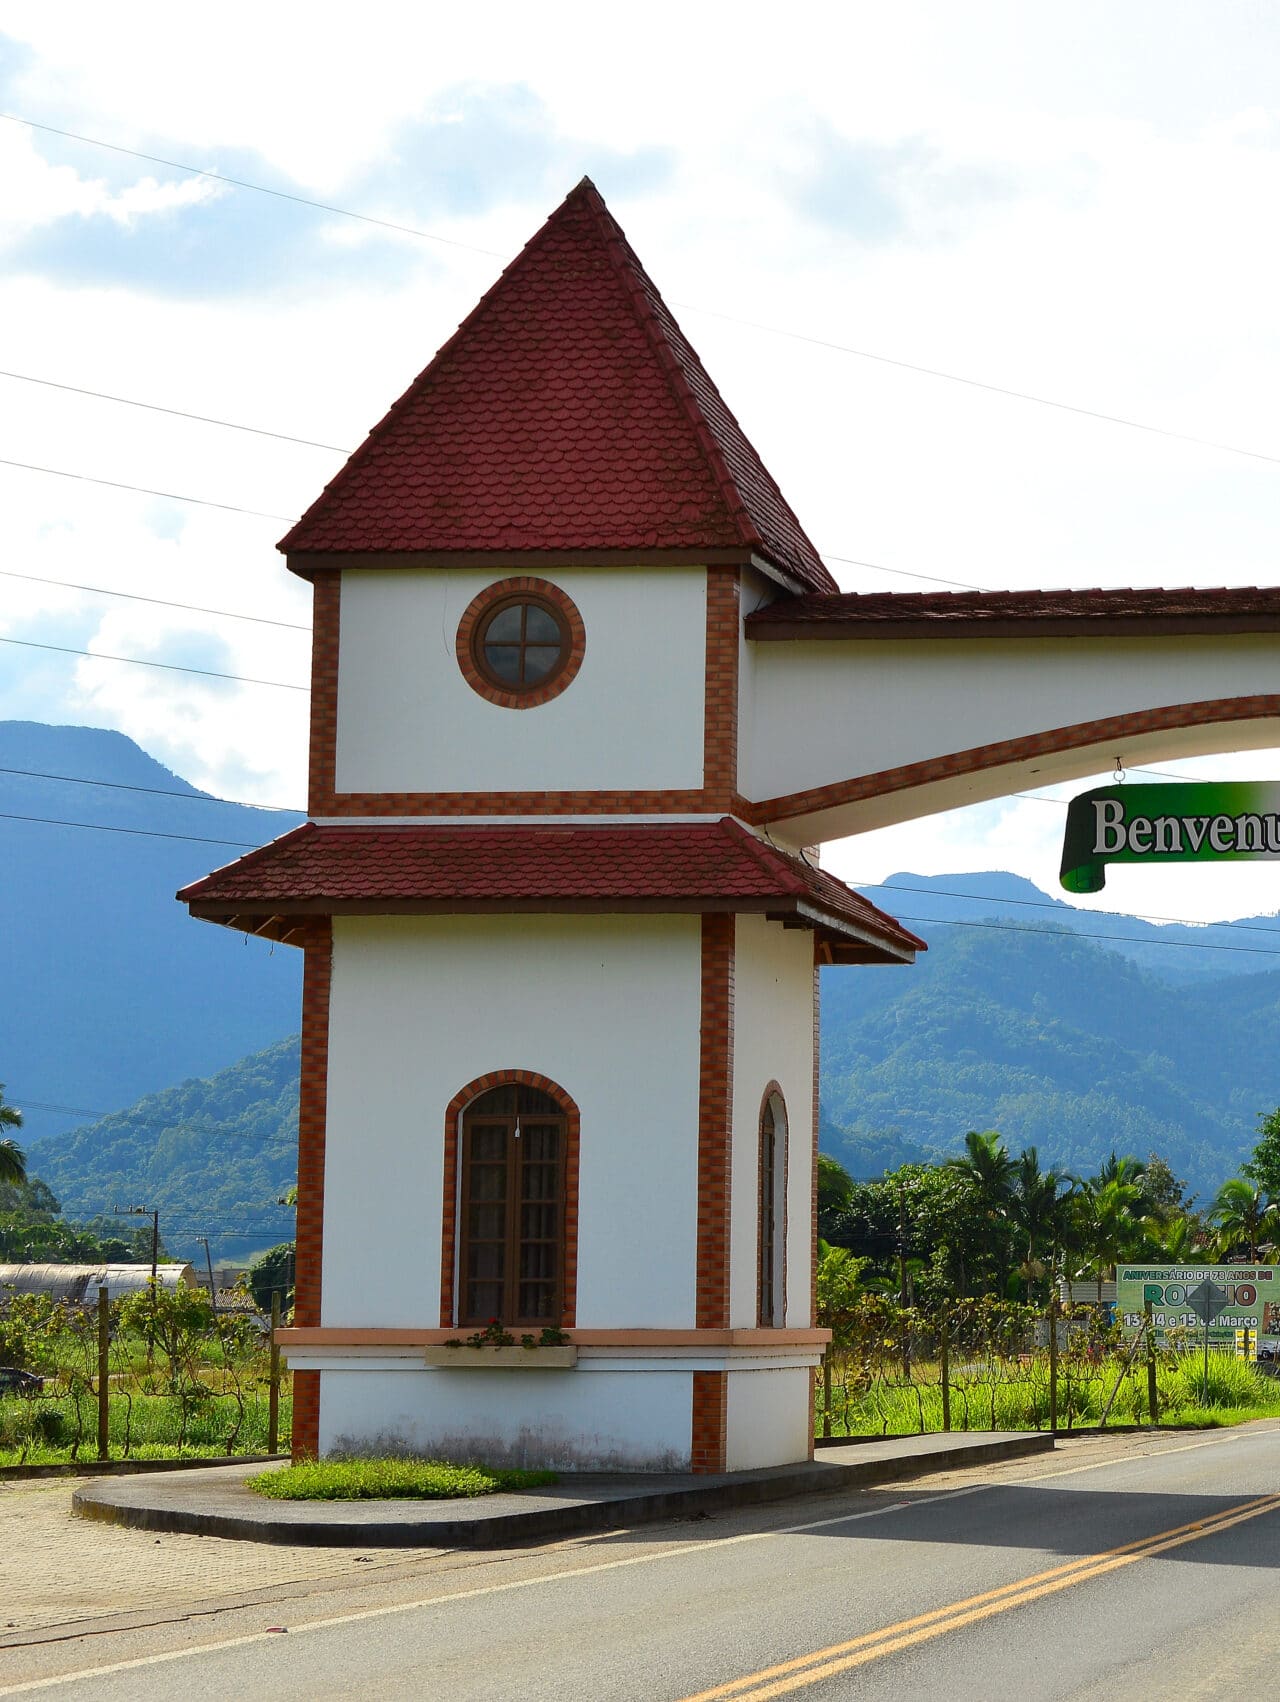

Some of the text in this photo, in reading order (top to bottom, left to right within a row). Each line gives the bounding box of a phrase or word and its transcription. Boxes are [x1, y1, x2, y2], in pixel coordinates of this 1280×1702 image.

[1123, 1268, 1195, 1280] ANIVERSÁRIO
[1227, 1270, 1256, 1280] ANOS
[1257, 1270, 1273, 1280] DE
[1144, 1283, 1257, 1306] ROIO
[1168, 1316, 1177, 1327] e
[1180, 1313, 1197, 1326] 15
[1219, 1315, 1258, 1328] Março
